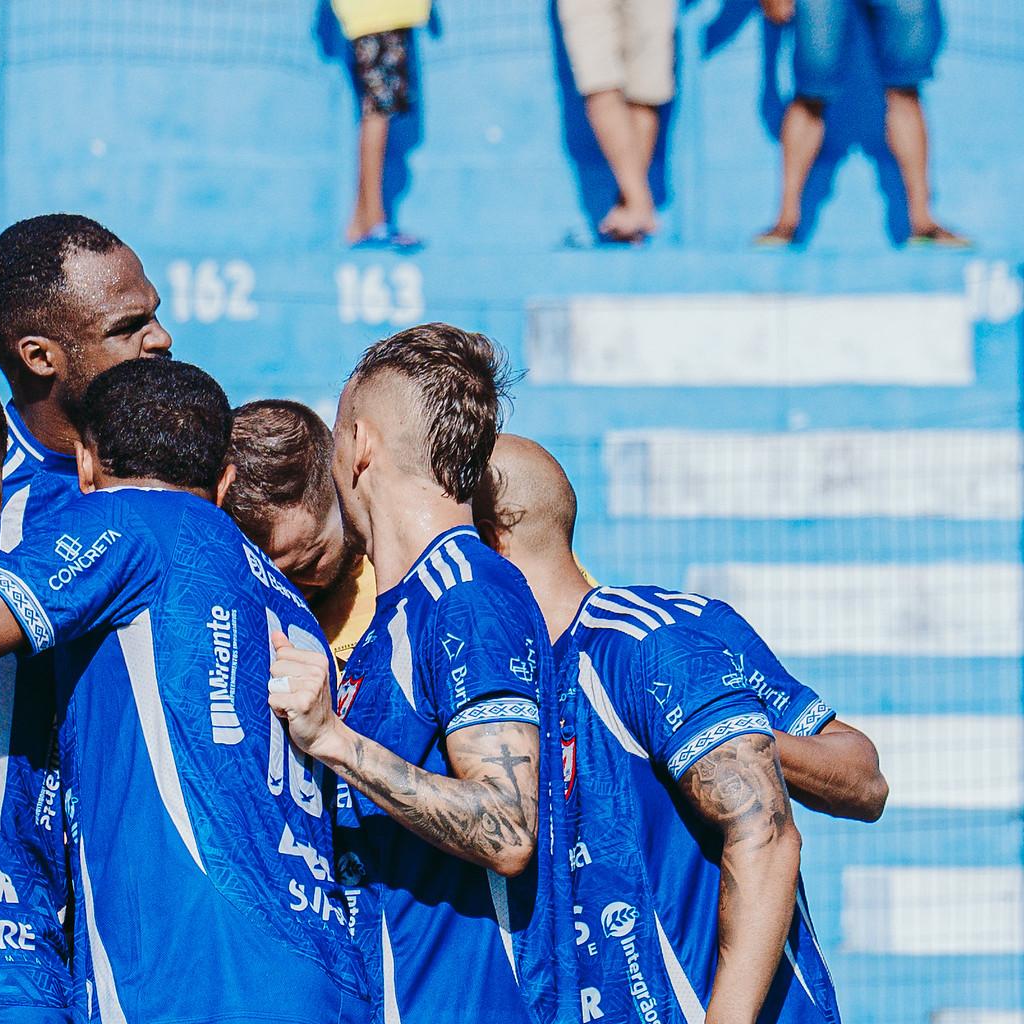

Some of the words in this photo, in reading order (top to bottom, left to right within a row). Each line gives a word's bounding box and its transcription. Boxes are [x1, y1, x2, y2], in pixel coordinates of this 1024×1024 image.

[168, 258, 257, 323] 162
[334, 261, 425, 325] 163
[49, 529, 122, 590] CONCRETA
[206, 605, 231, 700] Mirante
